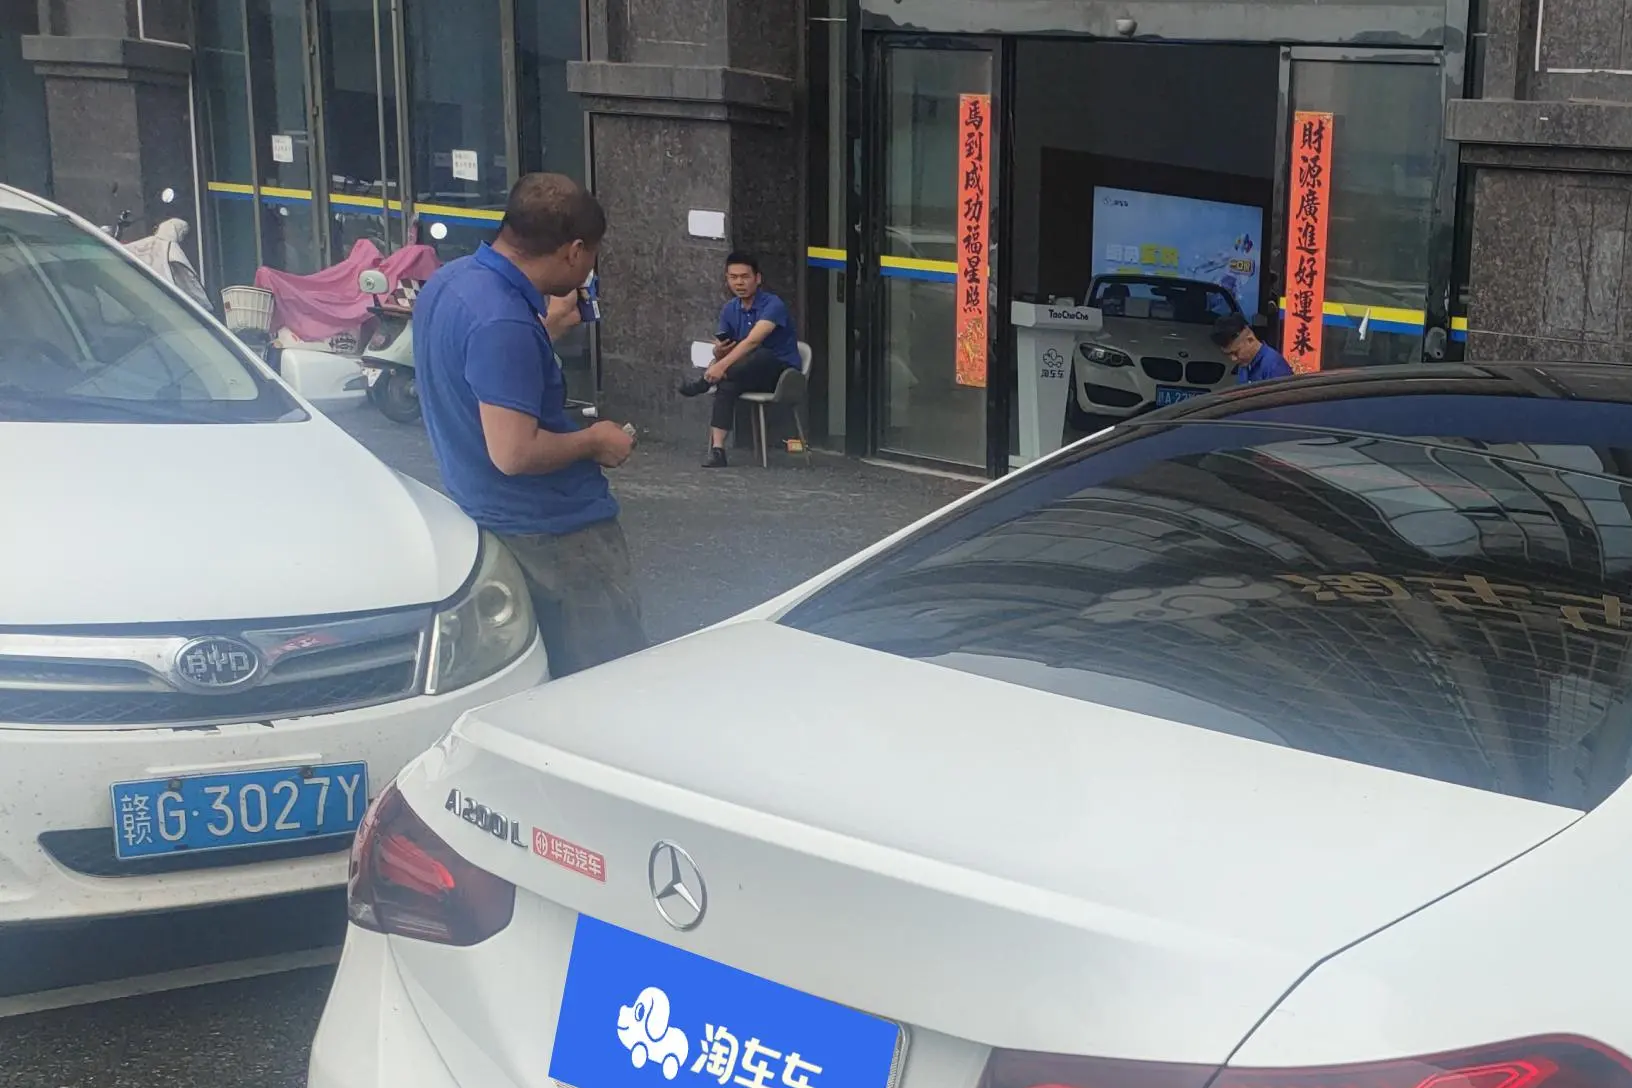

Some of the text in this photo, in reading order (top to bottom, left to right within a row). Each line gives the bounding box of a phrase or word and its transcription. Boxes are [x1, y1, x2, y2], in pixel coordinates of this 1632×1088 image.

[963, 100, 984, 315] 馬到成功福星照
[186, 648, 250, 676] BYD
